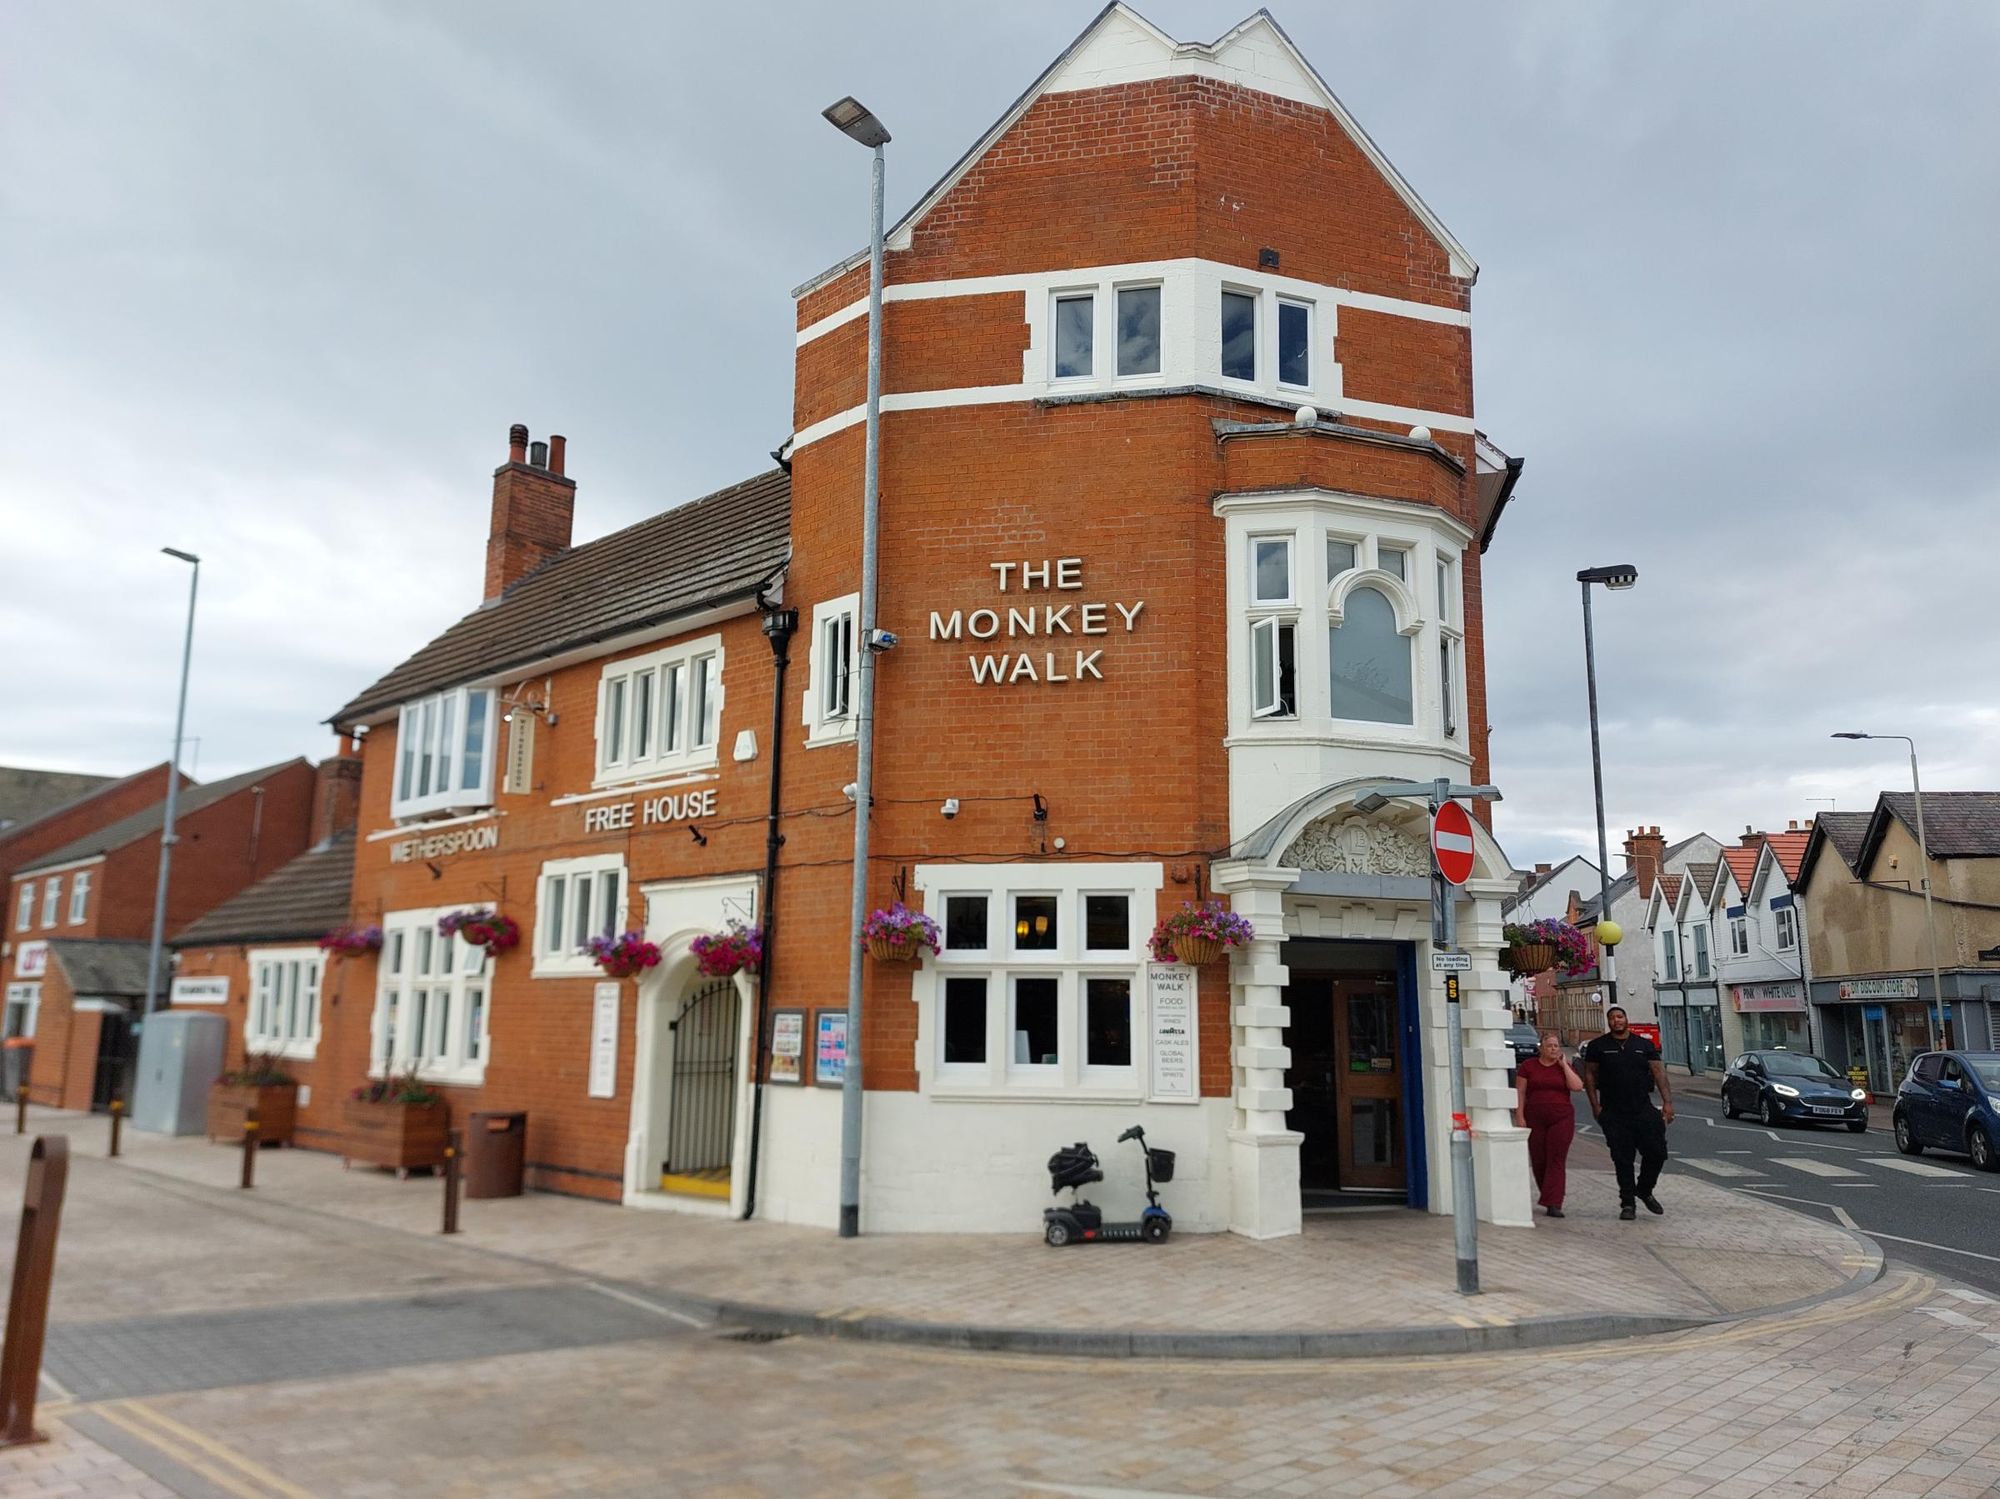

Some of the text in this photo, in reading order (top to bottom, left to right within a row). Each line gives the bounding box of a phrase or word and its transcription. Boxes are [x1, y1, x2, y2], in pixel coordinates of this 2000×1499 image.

[990, 558, 1083, 592] THE
[929, 601, 1145, 641] MONKEY
[969, 650, 1104, 685] WALK
[585, 788, 719, 833] FREE HOUSE
[389, 825, 498, 864] WETHERSPOON
[1150, 972, 1191, 981] MONKEY
[1156, 982, 1184, 991] WALK
[1886, 979, 1904, 993] STORE
[1159, 997, 1184, 1005] FOOD
[1743, 987, 1755, 999] PINK
[1761, 985, 1780, 999] WHITE
